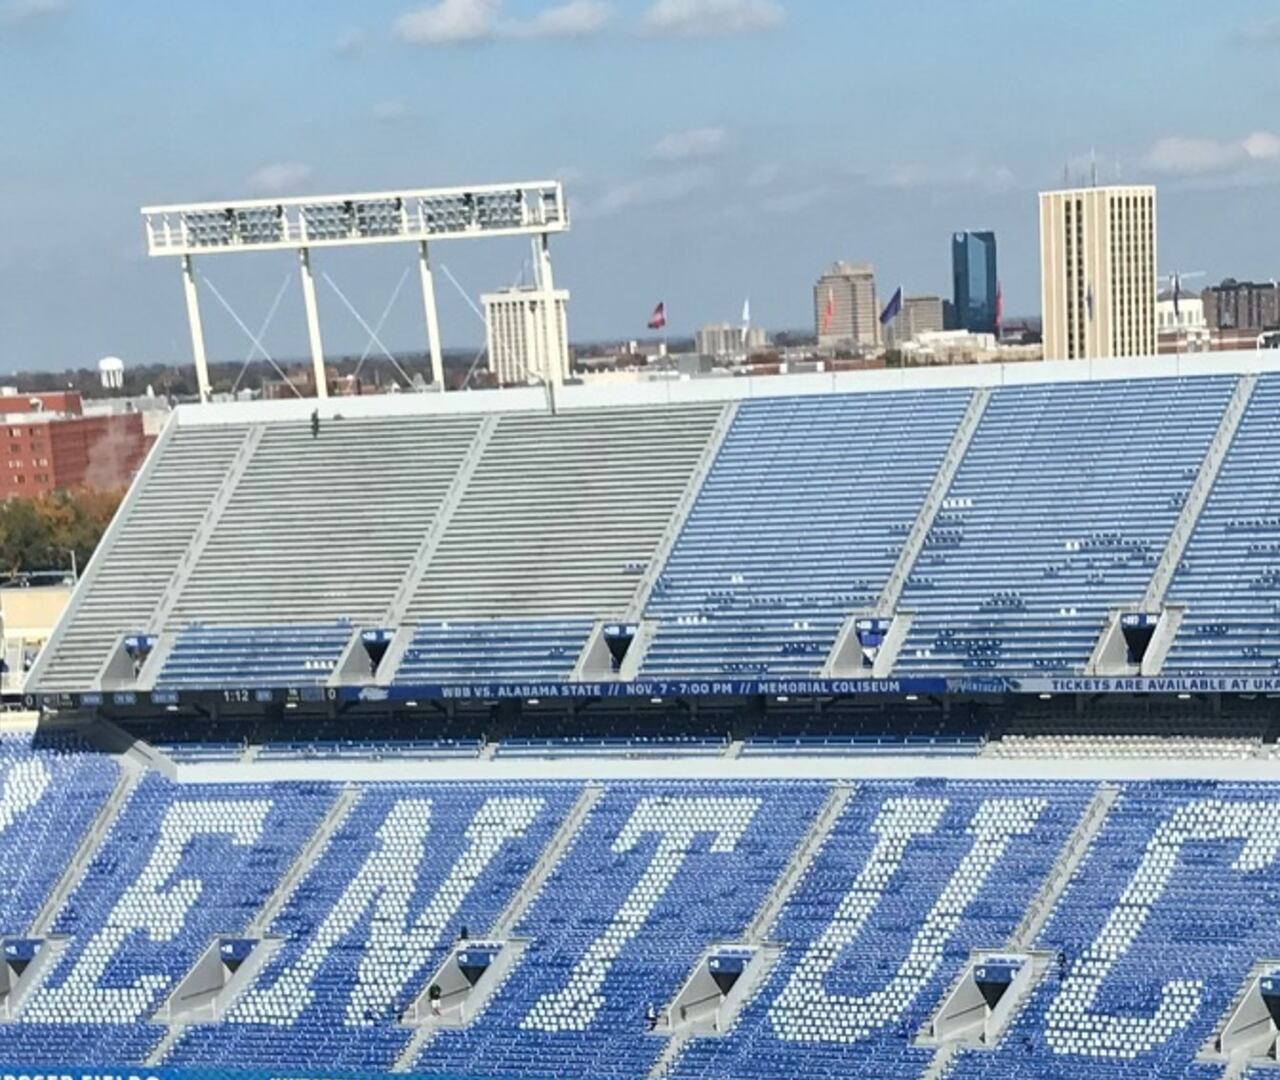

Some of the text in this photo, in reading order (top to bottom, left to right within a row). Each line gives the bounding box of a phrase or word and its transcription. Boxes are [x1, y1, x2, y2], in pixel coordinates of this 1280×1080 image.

[442, 687, 470, 698] WBB
[474, 687, 495, 698] VS.
[498, 686, 558, 697] ALABAMA
[562, 686, 601, 697] STATE
[626, 684, 656, 695] NOV.
[661, 684, 667, 694] 7
[680, 684, 709, 694] 7:00
[713, 683, 732, 693] PM
[758, 682, 829, 693] MEMORIAL
[831, 681, 900, 693] COLISEUM
[1051, 680, 1110, 691] TICKETS
[1114, 680, 1143, 691] ARE
[1148, 679, 1226, 690] AVAILABLE
[1231, 679, 1248, 690] AT
